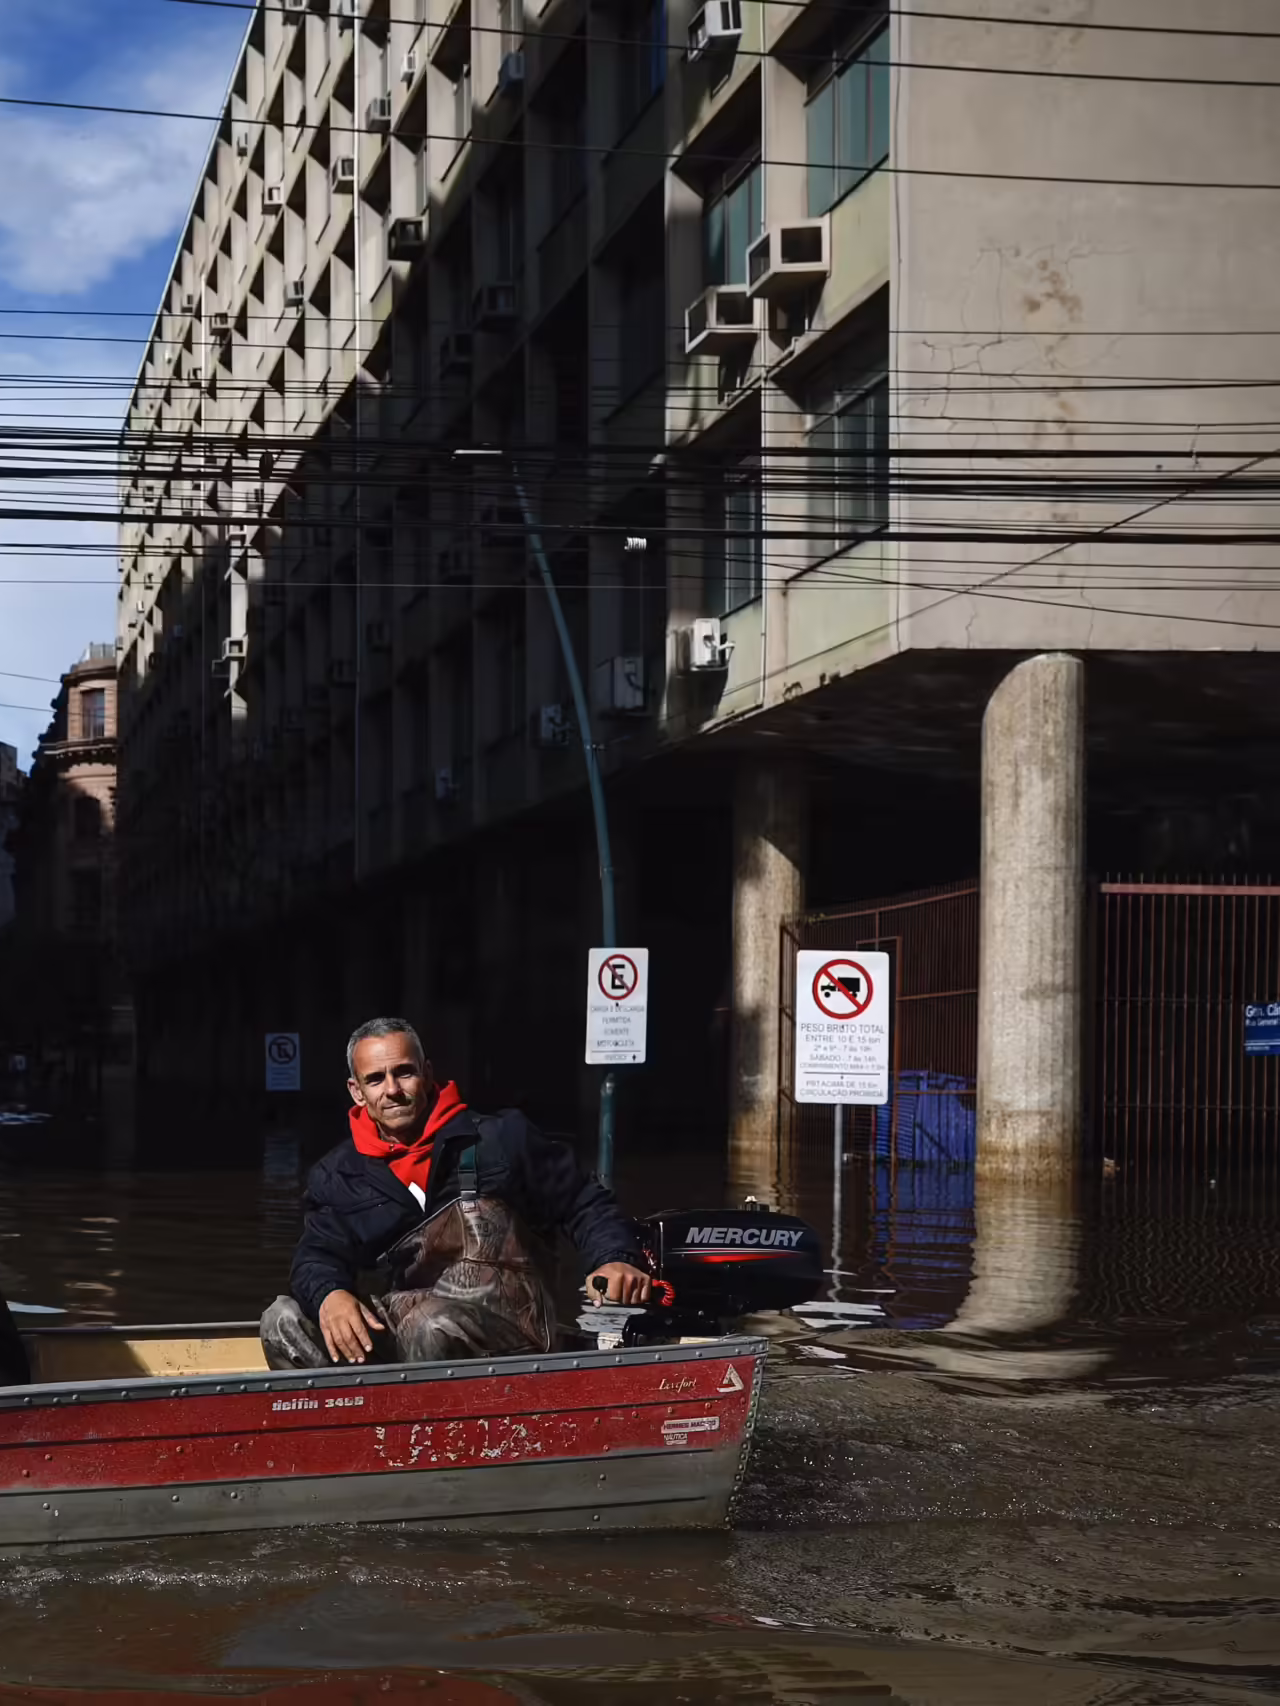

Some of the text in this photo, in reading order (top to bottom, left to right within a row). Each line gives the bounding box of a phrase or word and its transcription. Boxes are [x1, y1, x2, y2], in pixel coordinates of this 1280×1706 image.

[800, 1023, 885, 1034] PESO BRUTO TOTAL
[805, 1034, 834, 1042] ENTRE
[838, 1035, 847, 1043] 10
[849, 1035, 855, 1043] E
[685, 1227, 804, 1247] MERCURY
